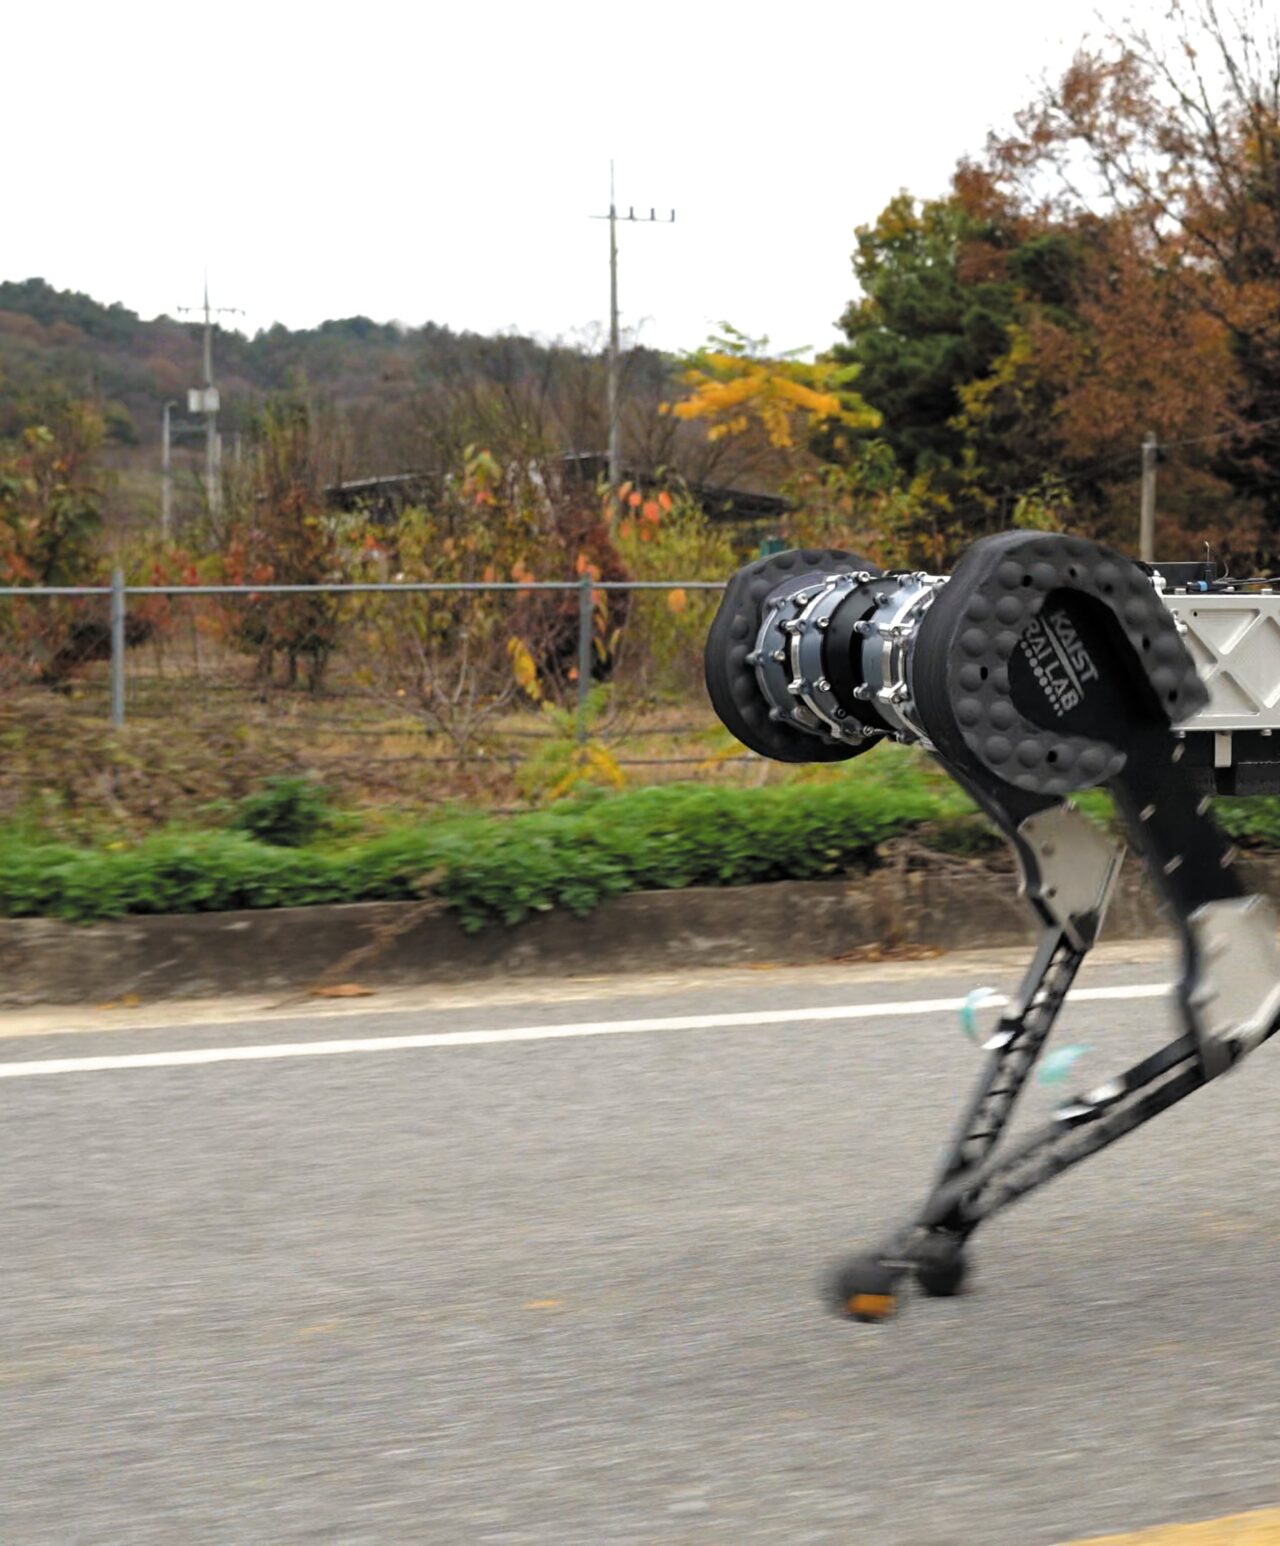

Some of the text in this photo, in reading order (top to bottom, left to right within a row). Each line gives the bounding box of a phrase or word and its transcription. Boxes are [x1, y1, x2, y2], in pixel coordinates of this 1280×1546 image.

[1025, 618, 1079, 711] RAI LAB
[1050, 610, 1099, 682] KAIST
